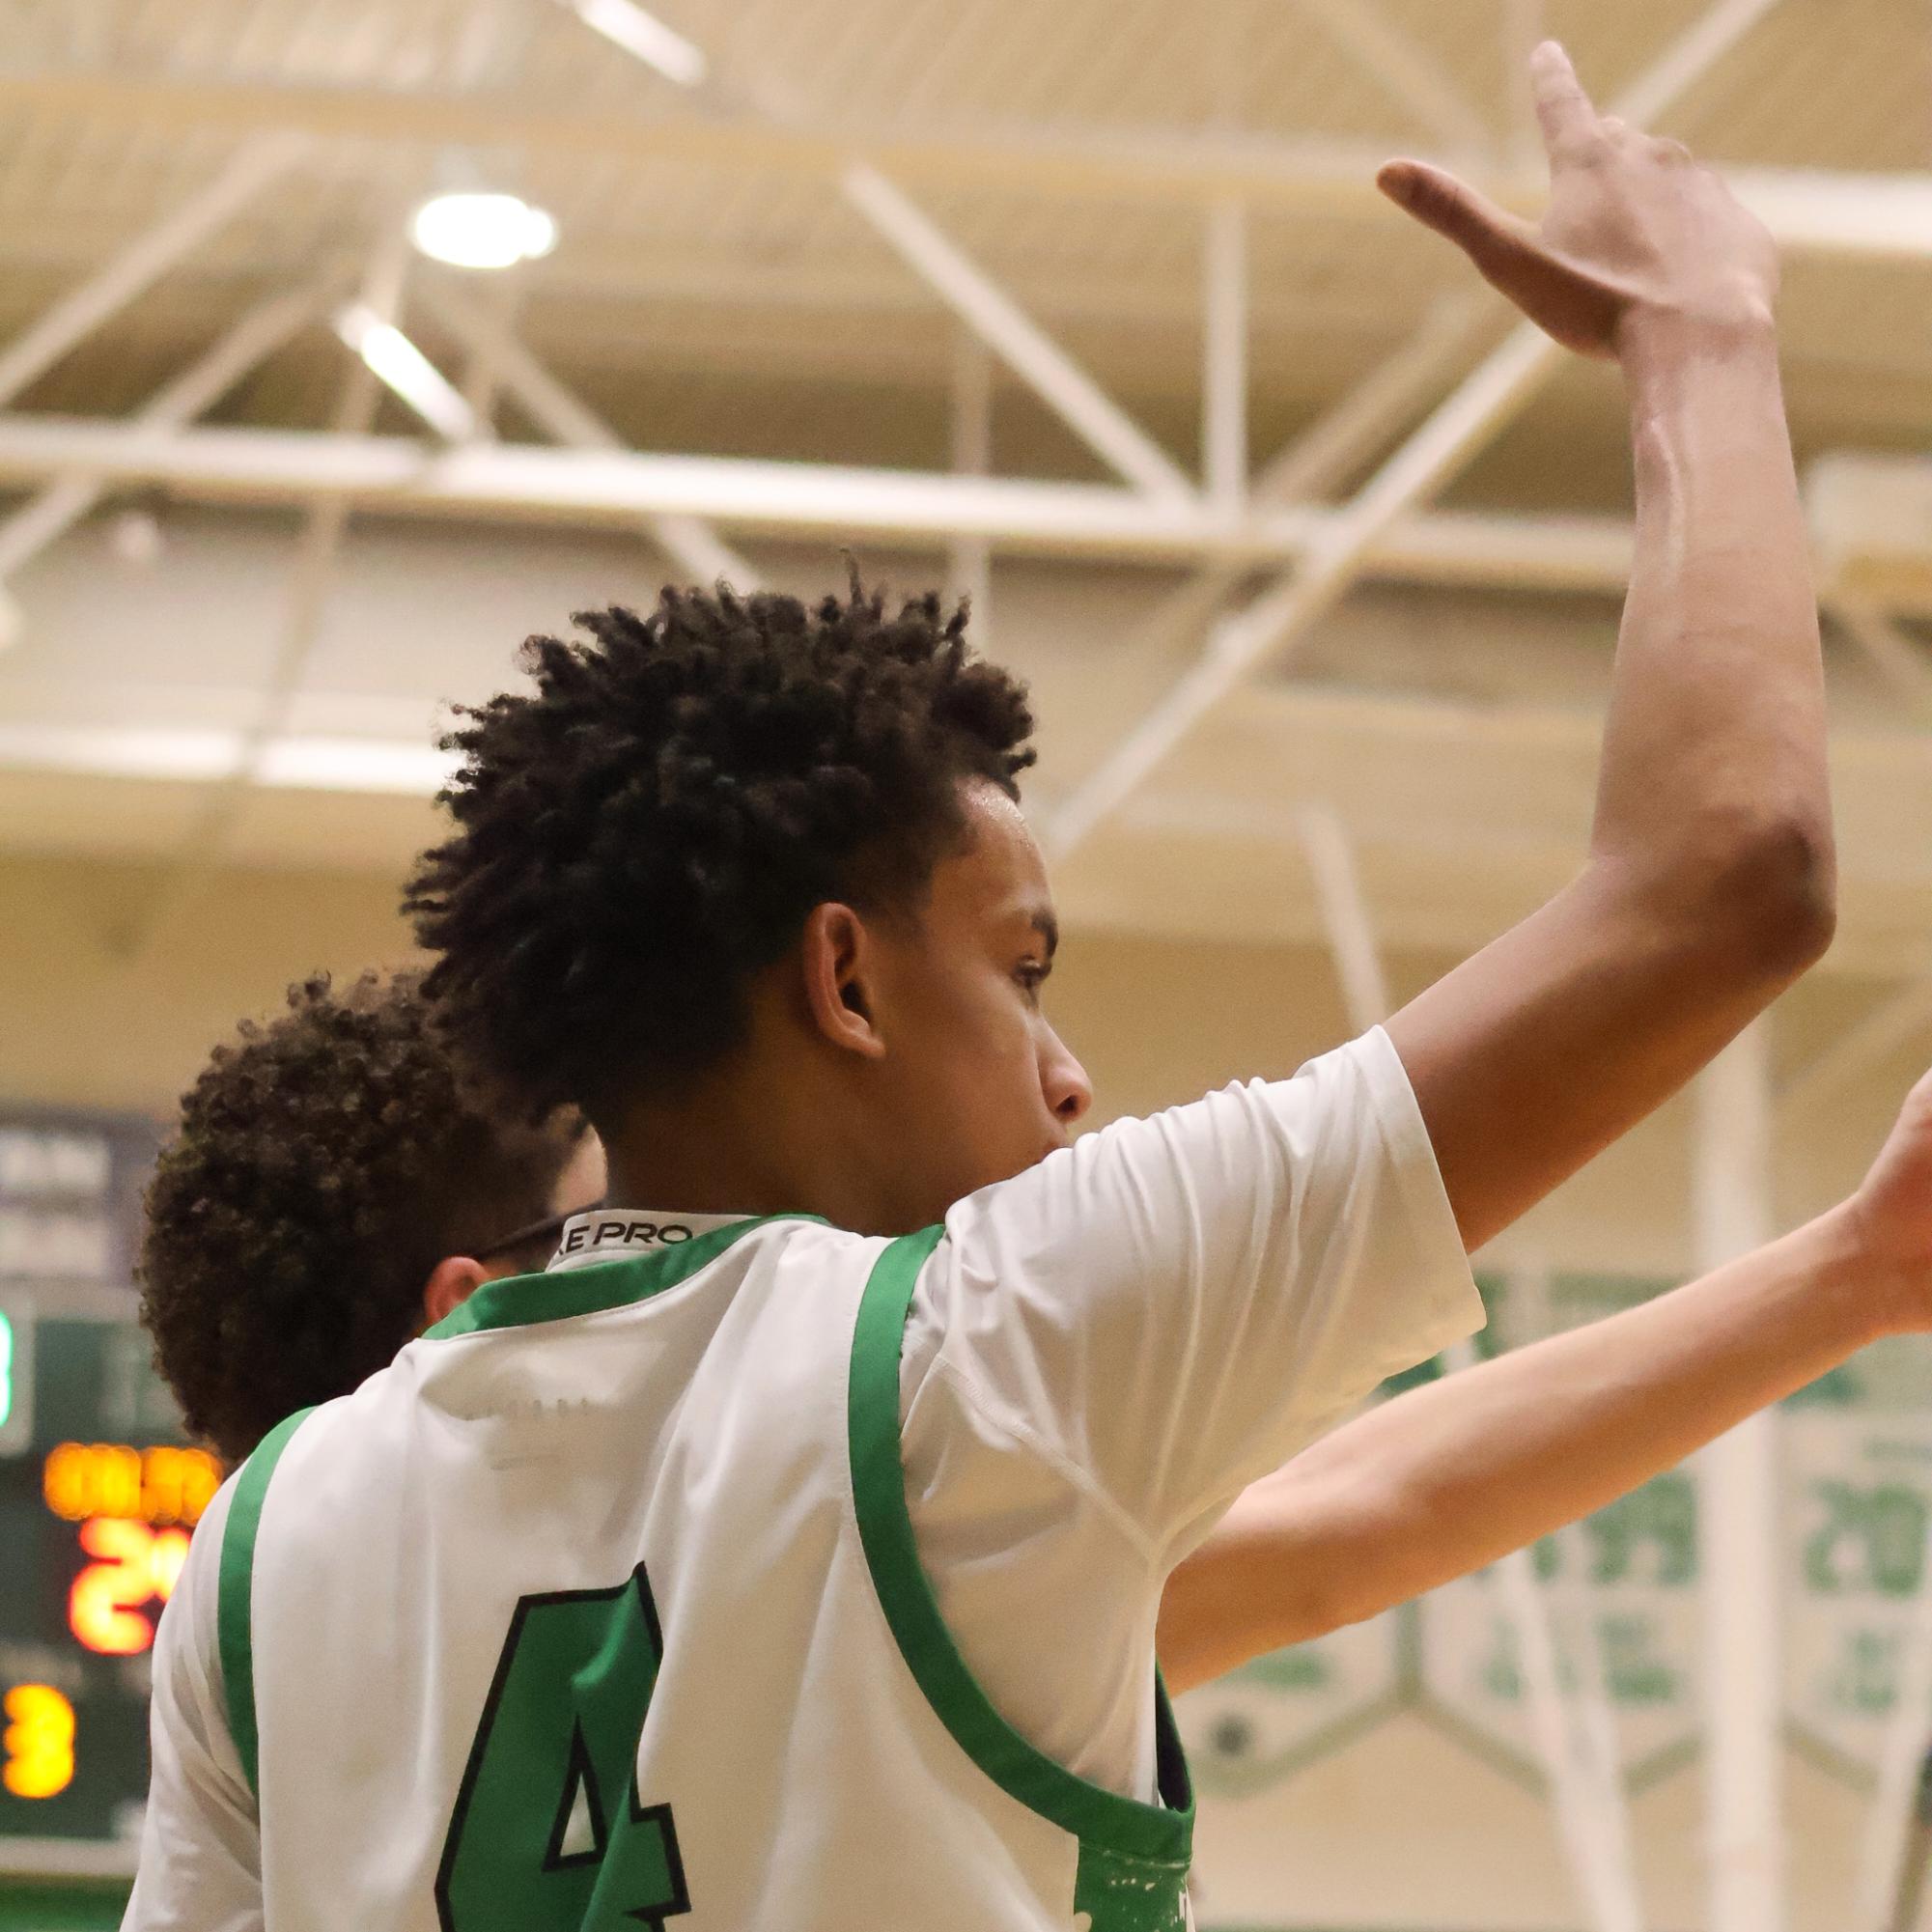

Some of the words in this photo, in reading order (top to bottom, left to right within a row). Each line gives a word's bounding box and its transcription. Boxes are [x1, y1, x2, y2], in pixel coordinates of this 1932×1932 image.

[559, 1225, 591, 1255] E
[593, 1221, 693, 1246] PRO
[434, 1561, 691, 1932] 4
